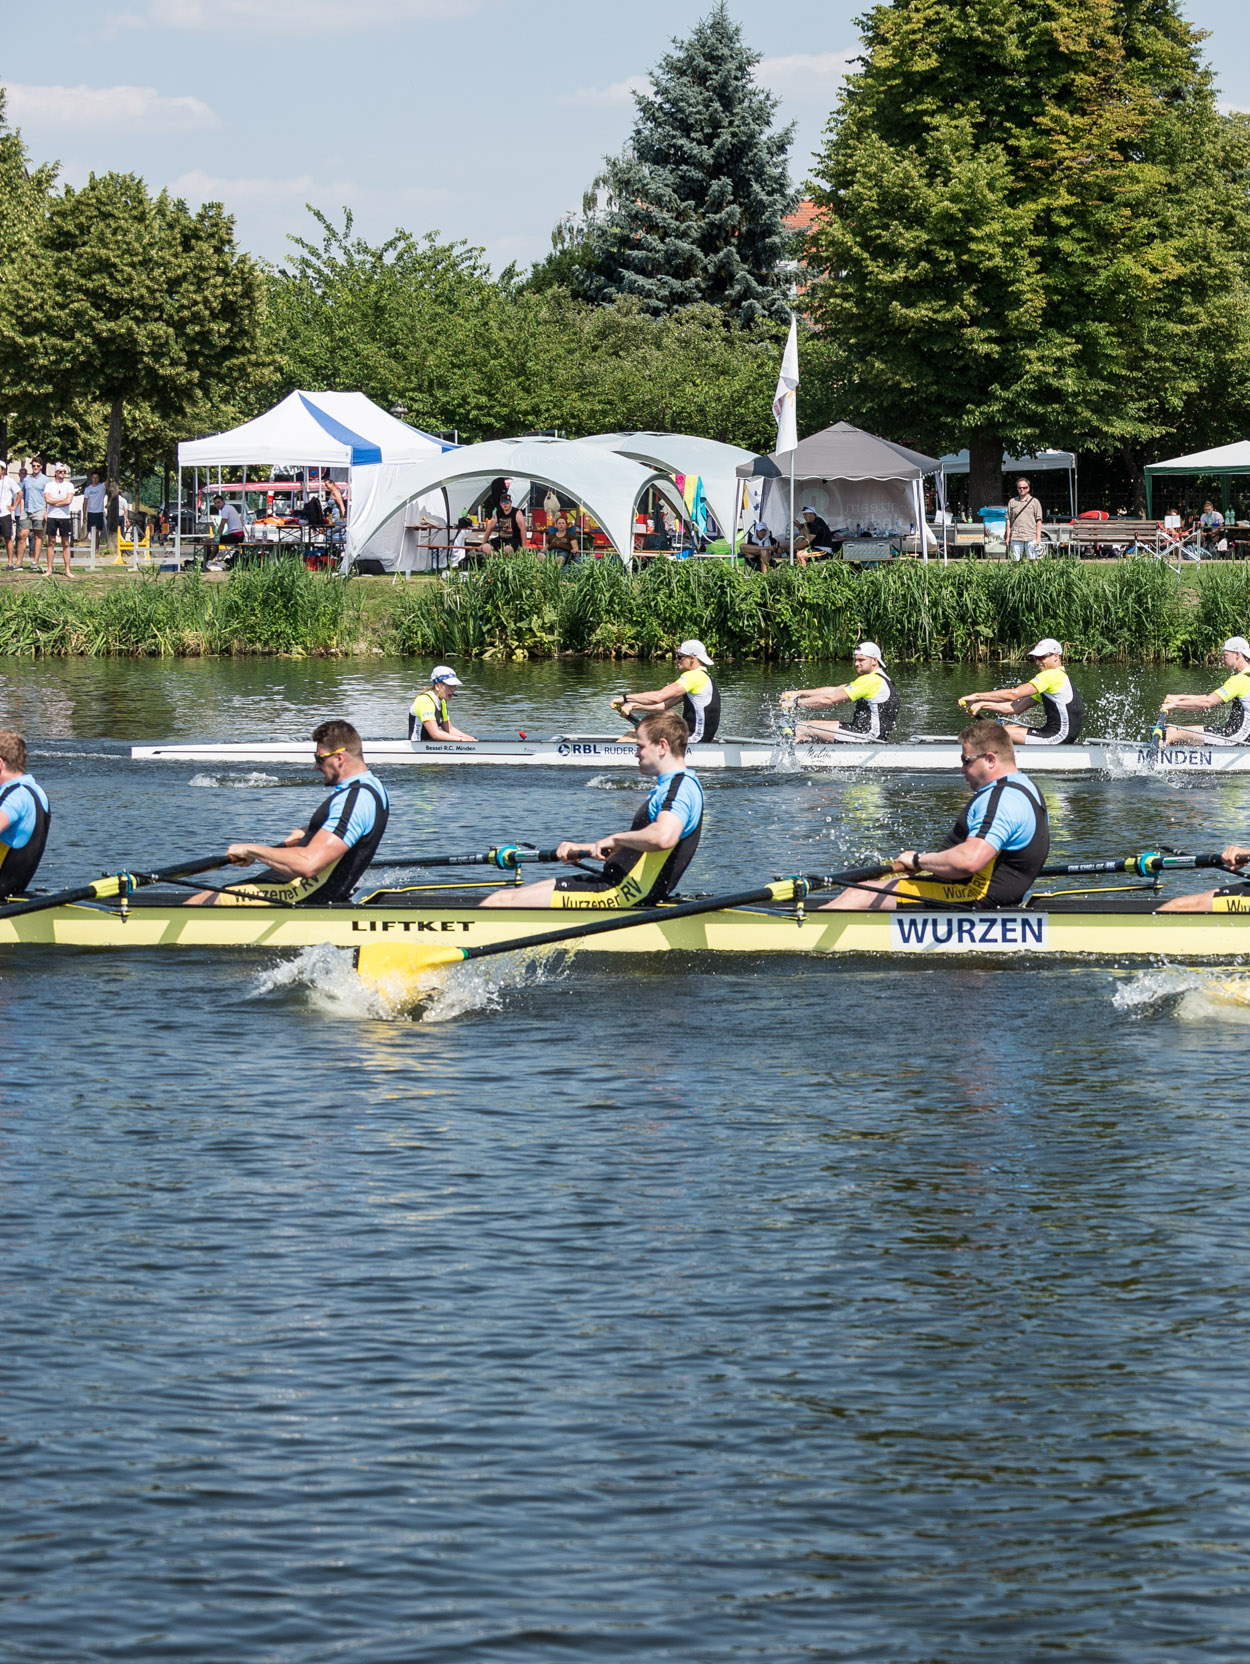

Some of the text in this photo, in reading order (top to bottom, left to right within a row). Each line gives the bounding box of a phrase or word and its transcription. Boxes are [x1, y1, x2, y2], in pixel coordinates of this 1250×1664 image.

[572, 743, 601, 754] RBL
[620, 876, 642, 902] RV
[351, 921, 475, 932] LIFTKET
[897, 917, 1044, 944] WURZEN
